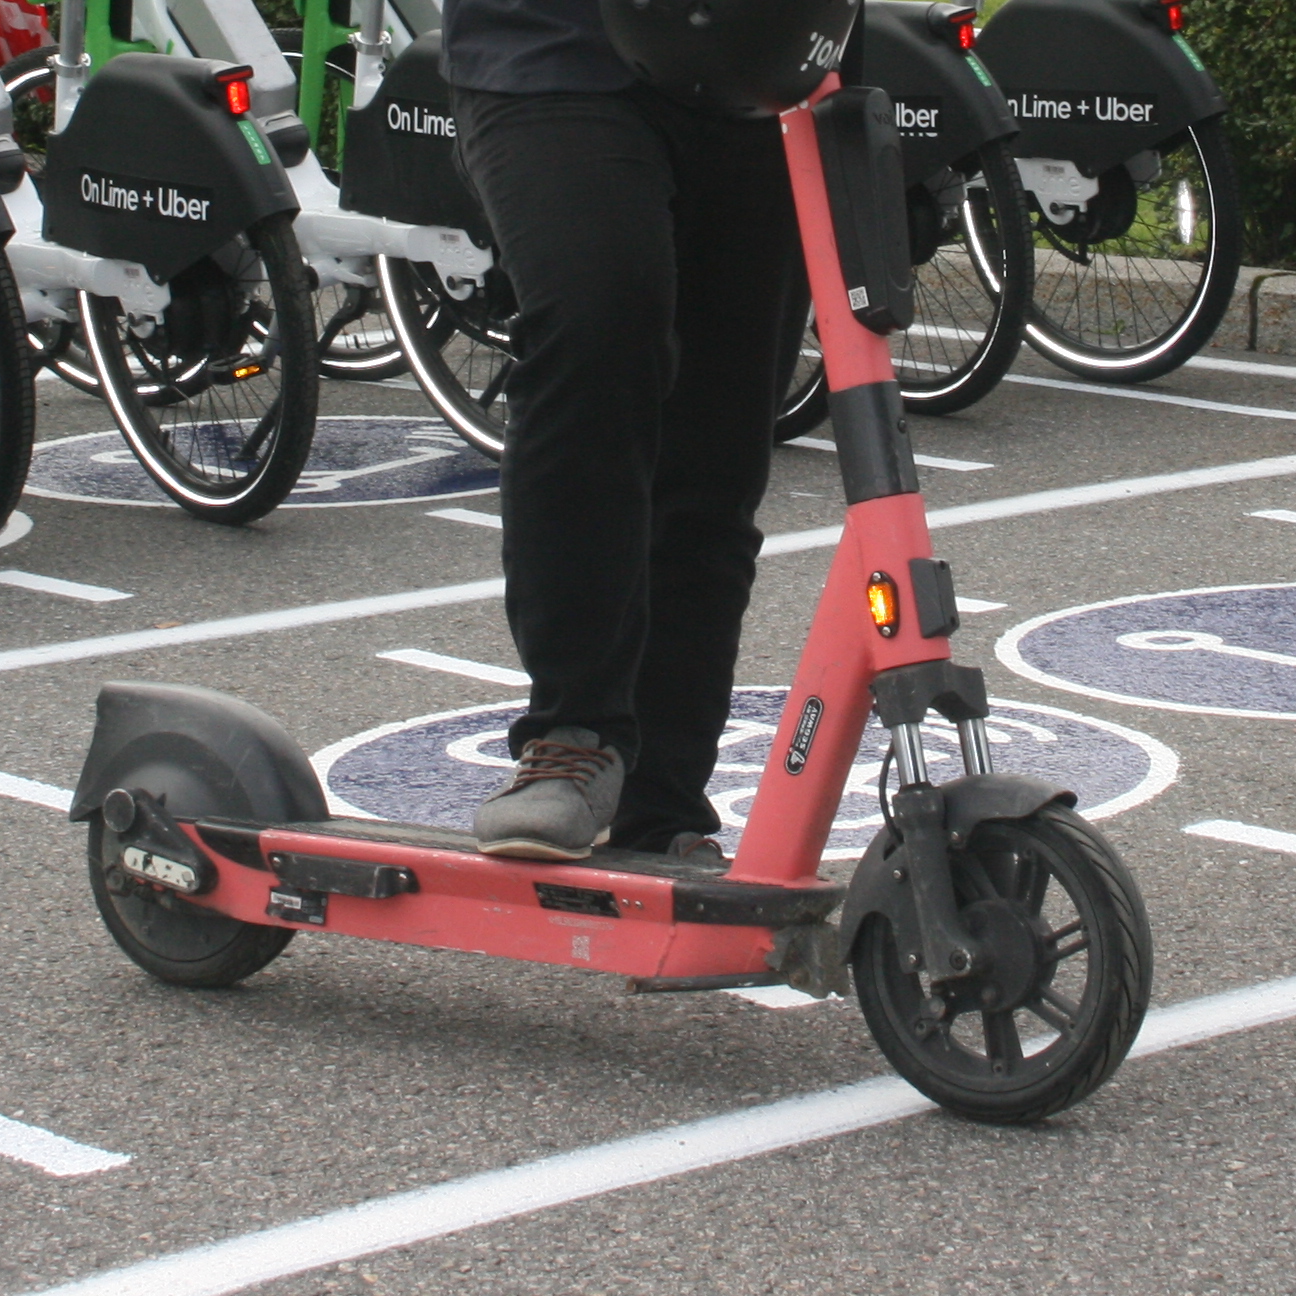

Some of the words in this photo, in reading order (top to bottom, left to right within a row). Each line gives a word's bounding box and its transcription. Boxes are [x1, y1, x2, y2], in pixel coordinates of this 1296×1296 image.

[387, 102, 411, 133] On
[413, 105, 457, 138] Lime
[1021, 93, 1071, 119] Lime
[1076, 102, 1090, 116] +
[1094, 96, 1154, 123] Uber
[80, 173, 100, 203] On
[100, 176, 139, 211] Lime
[142, 192, 155, 209] +
[157, 187, 210, 221] Uber
[799, 706, 819, 751] SEGWAY
